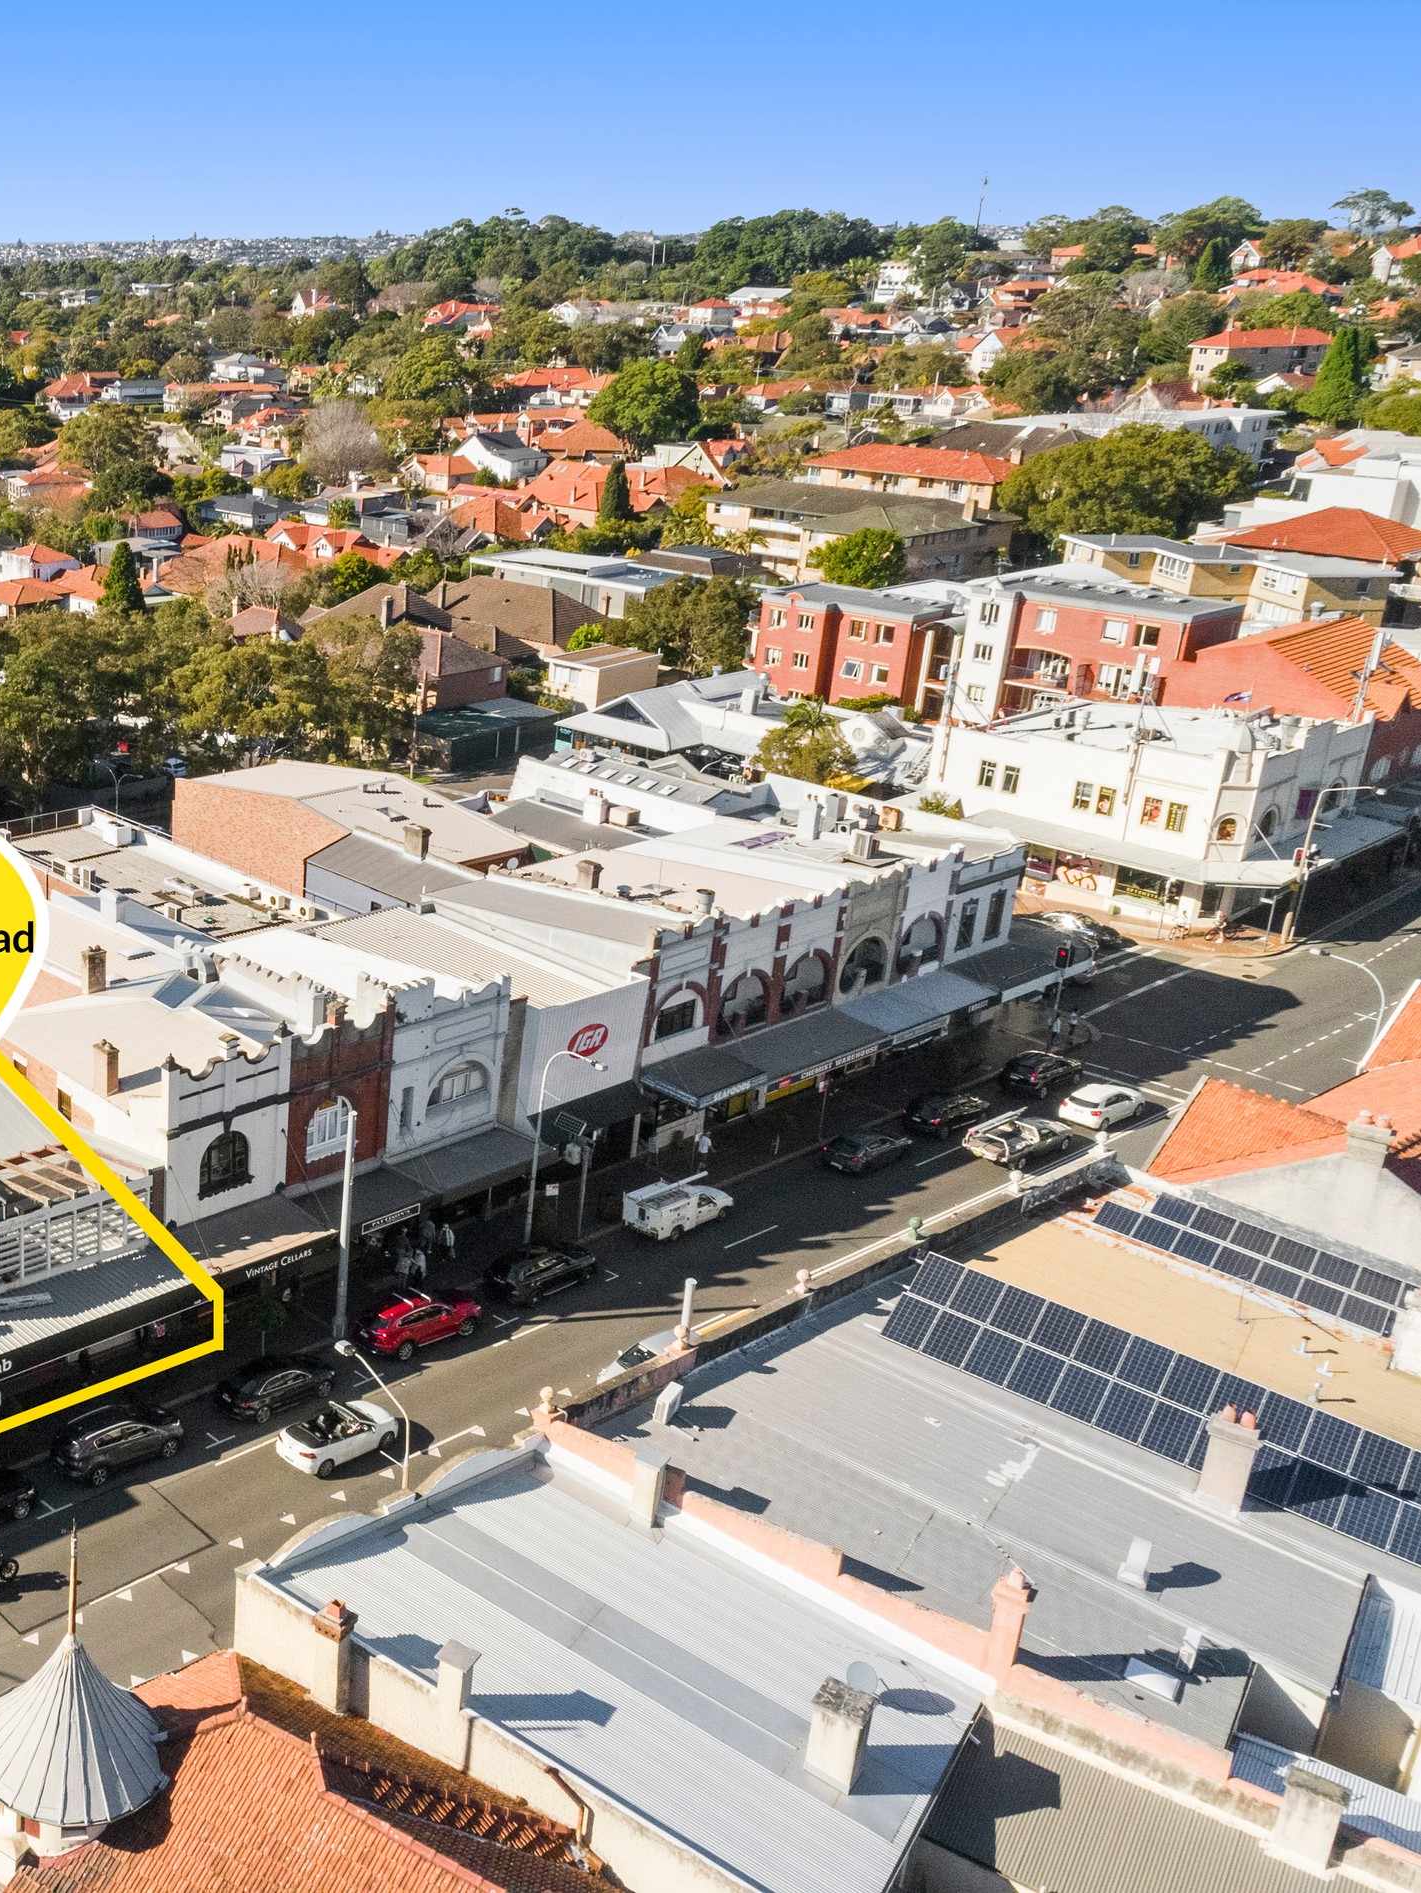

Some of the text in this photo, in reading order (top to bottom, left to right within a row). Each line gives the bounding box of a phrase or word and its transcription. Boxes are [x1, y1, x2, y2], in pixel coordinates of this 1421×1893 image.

[572, 1027, 605, 1053] IGA
[800, 1044, 879, 1079] CHEMIST WAREHOUSE
[245, 1249, 312, 1278] VINTAGE CELLARS
